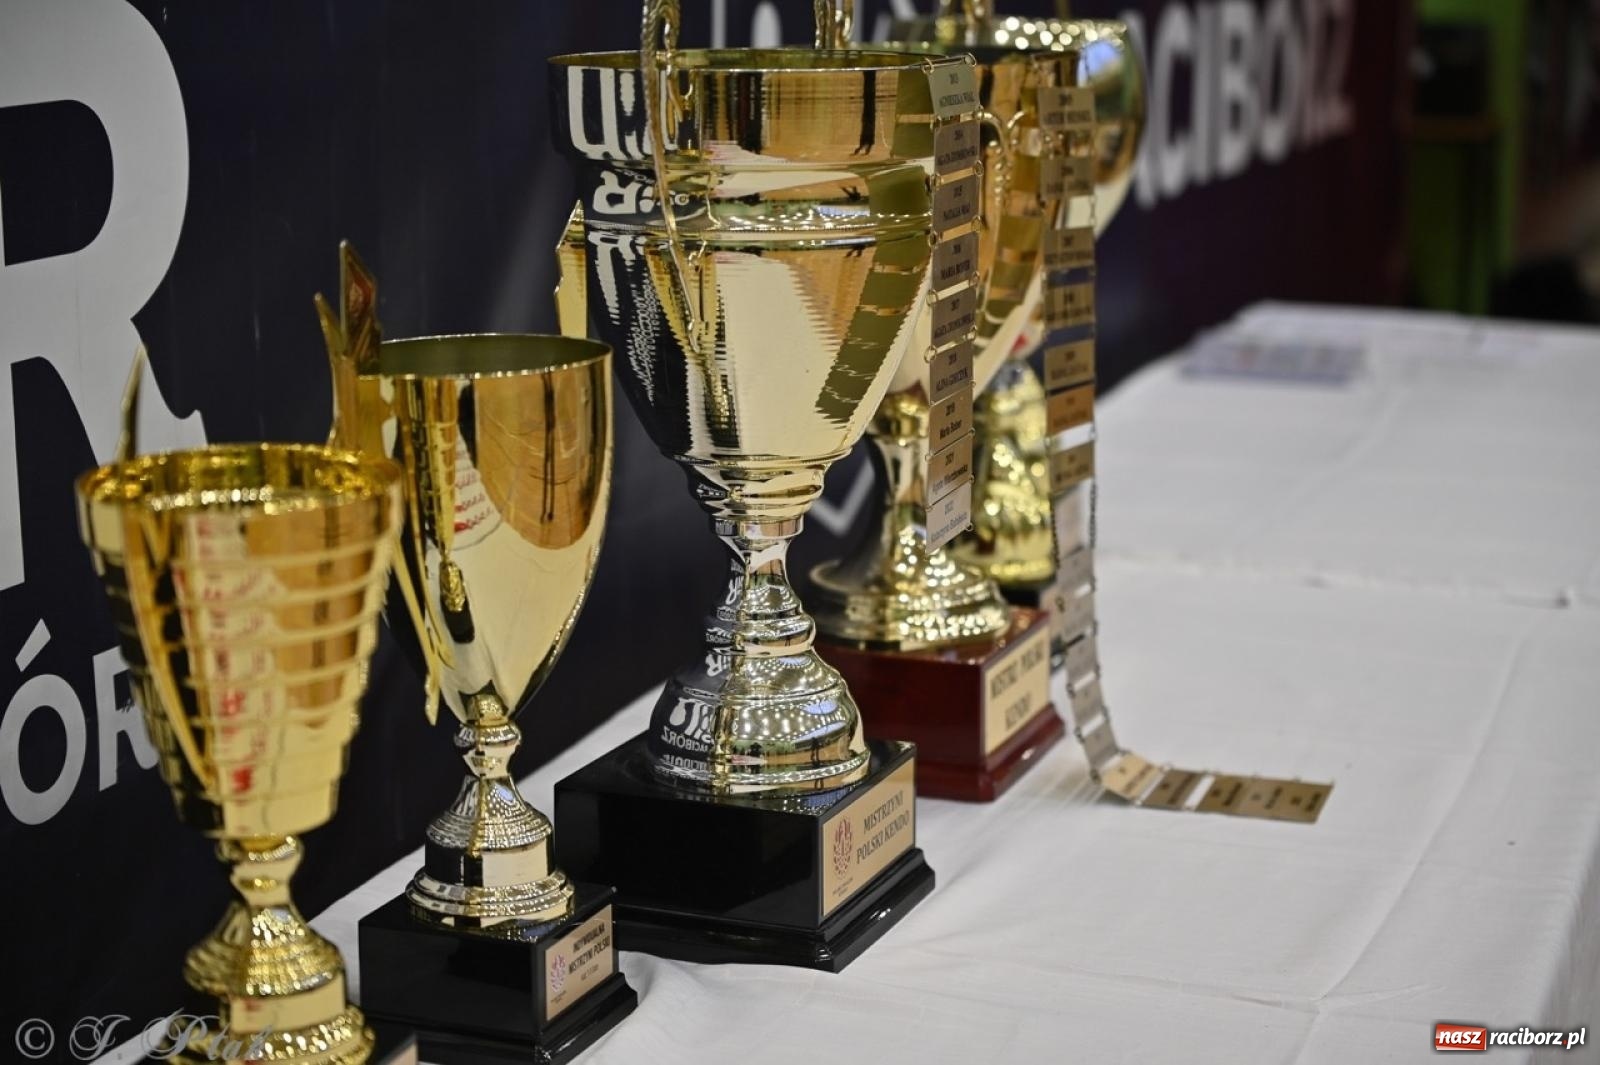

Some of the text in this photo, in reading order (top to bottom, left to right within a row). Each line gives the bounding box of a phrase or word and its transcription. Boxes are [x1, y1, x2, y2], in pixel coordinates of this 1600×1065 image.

[863, 791, 904, 835] MISTRZYNI
[856, 810, 910, 865] POLSKI KENDO
[593, 935, 611, 959] POLSKI
